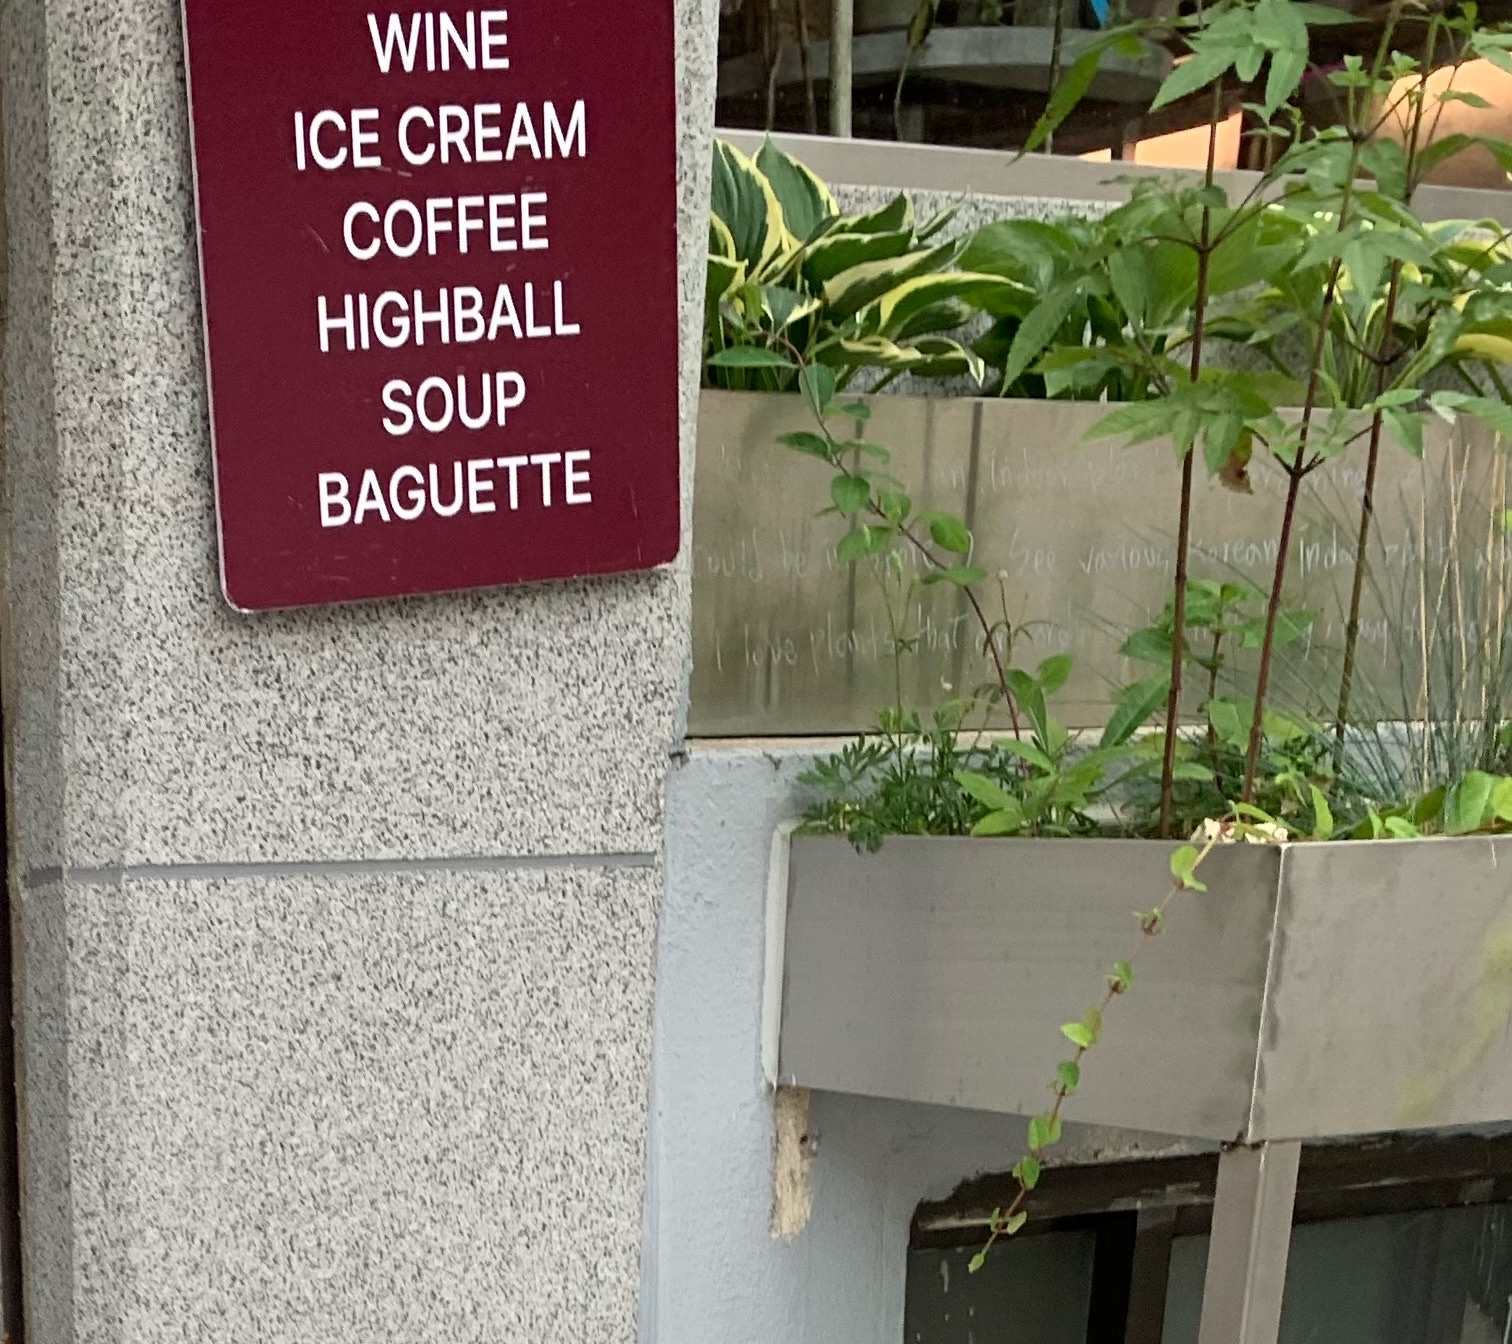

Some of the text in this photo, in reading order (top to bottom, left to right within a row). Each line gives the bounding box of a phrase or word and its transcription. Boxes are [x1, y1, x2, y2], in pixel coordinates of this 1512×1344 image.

[368, 10, 509, 73] WINE
[294, 99, 586, 170] ICE CREAM
[343, 192, 548, 260] COFFEE
[318, 280, 580, 352] HIGHBALL
[382, 371, 525, 435] SOUP
[318, 450, 591, 526] BAGUETTE
